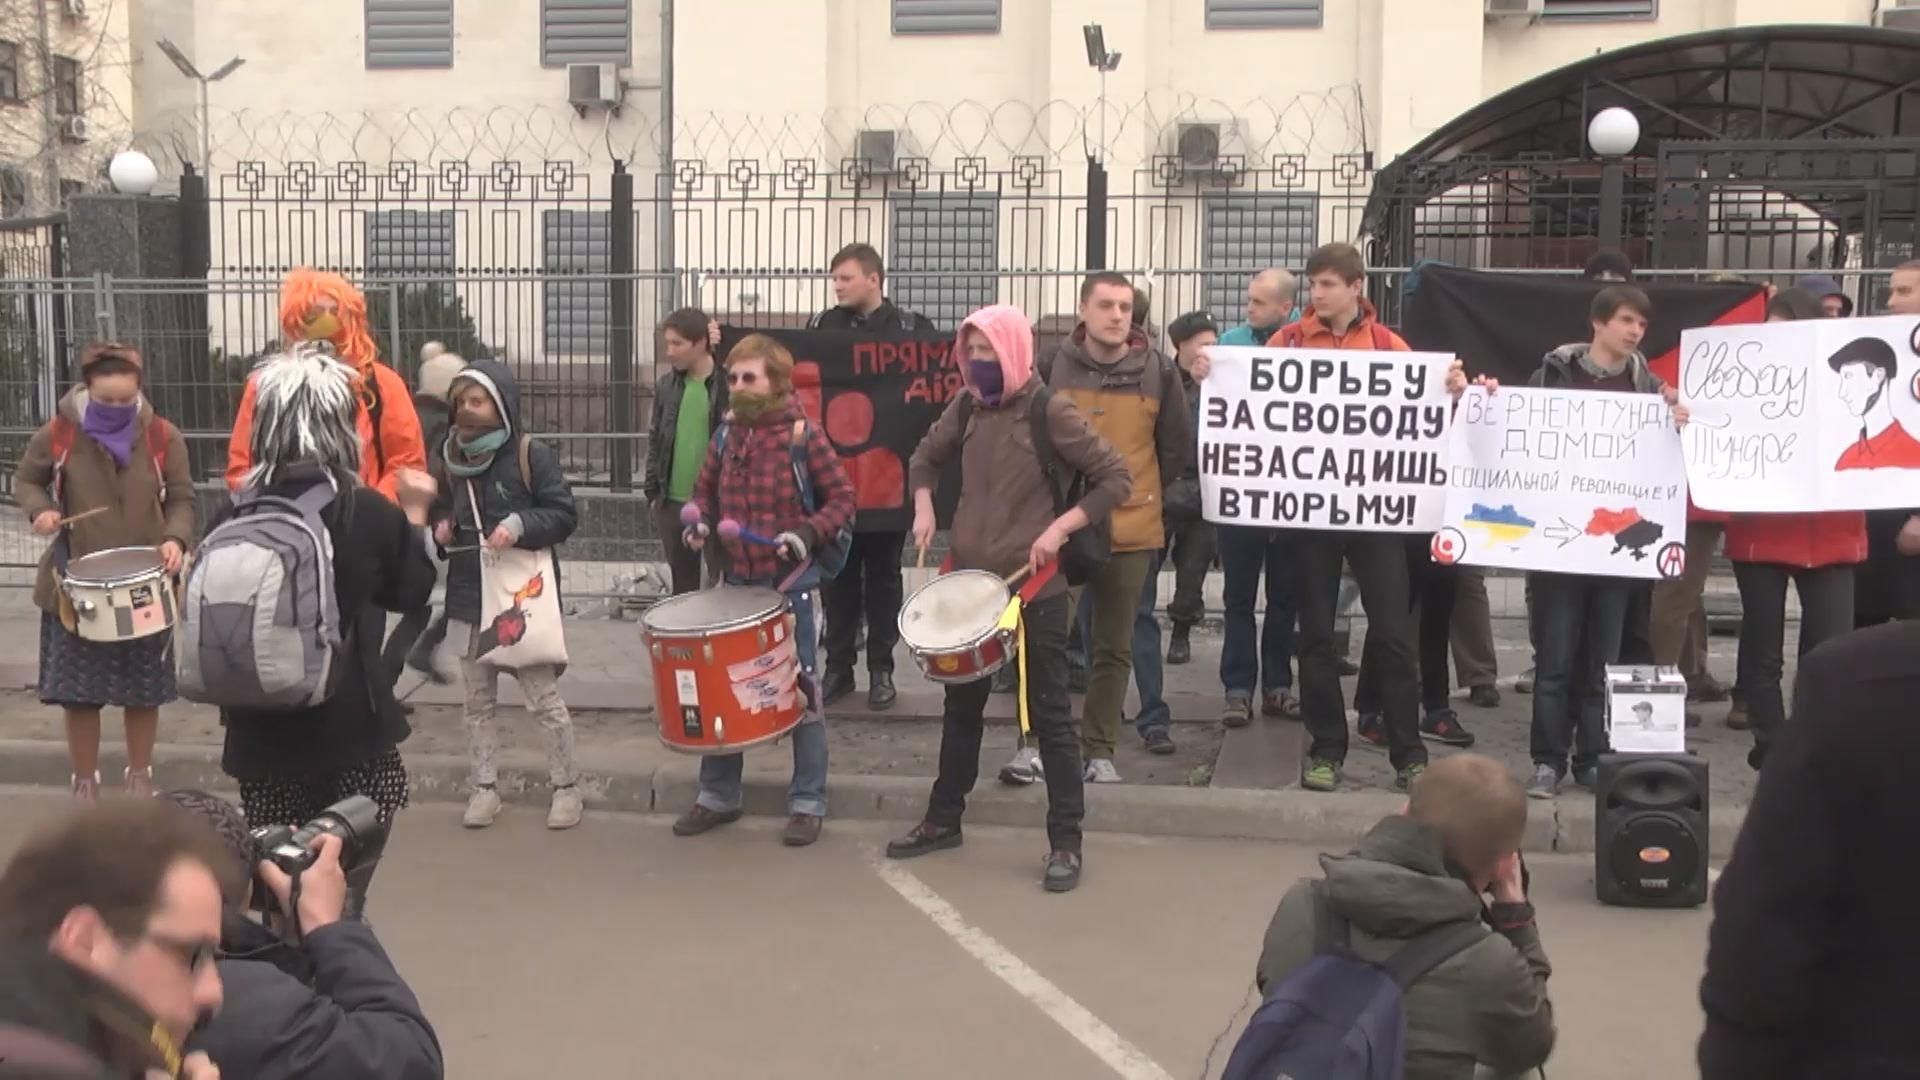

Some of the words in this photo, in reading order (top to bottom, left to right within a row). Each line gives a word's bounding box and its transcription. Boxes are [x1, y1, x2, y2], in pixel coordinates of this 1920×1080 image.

[853, 341, 958, 375] ПРЯМ
[1250, 357, 1427, 400] БОРЬБУ
[1684, 341, 1808, 419] Свободу
[1207, 397, 1255, 430] ЗА
[1263, 401, 1445, 440] СВОБОДУ
[1500, 429, 1636, 460] ДОМОЙ
[1450, 465, 1560, 493] СОЦИАЛЬНОЙ
[1570, 474, 1679, 501] РЕВОЛЮЦИЕЙ
